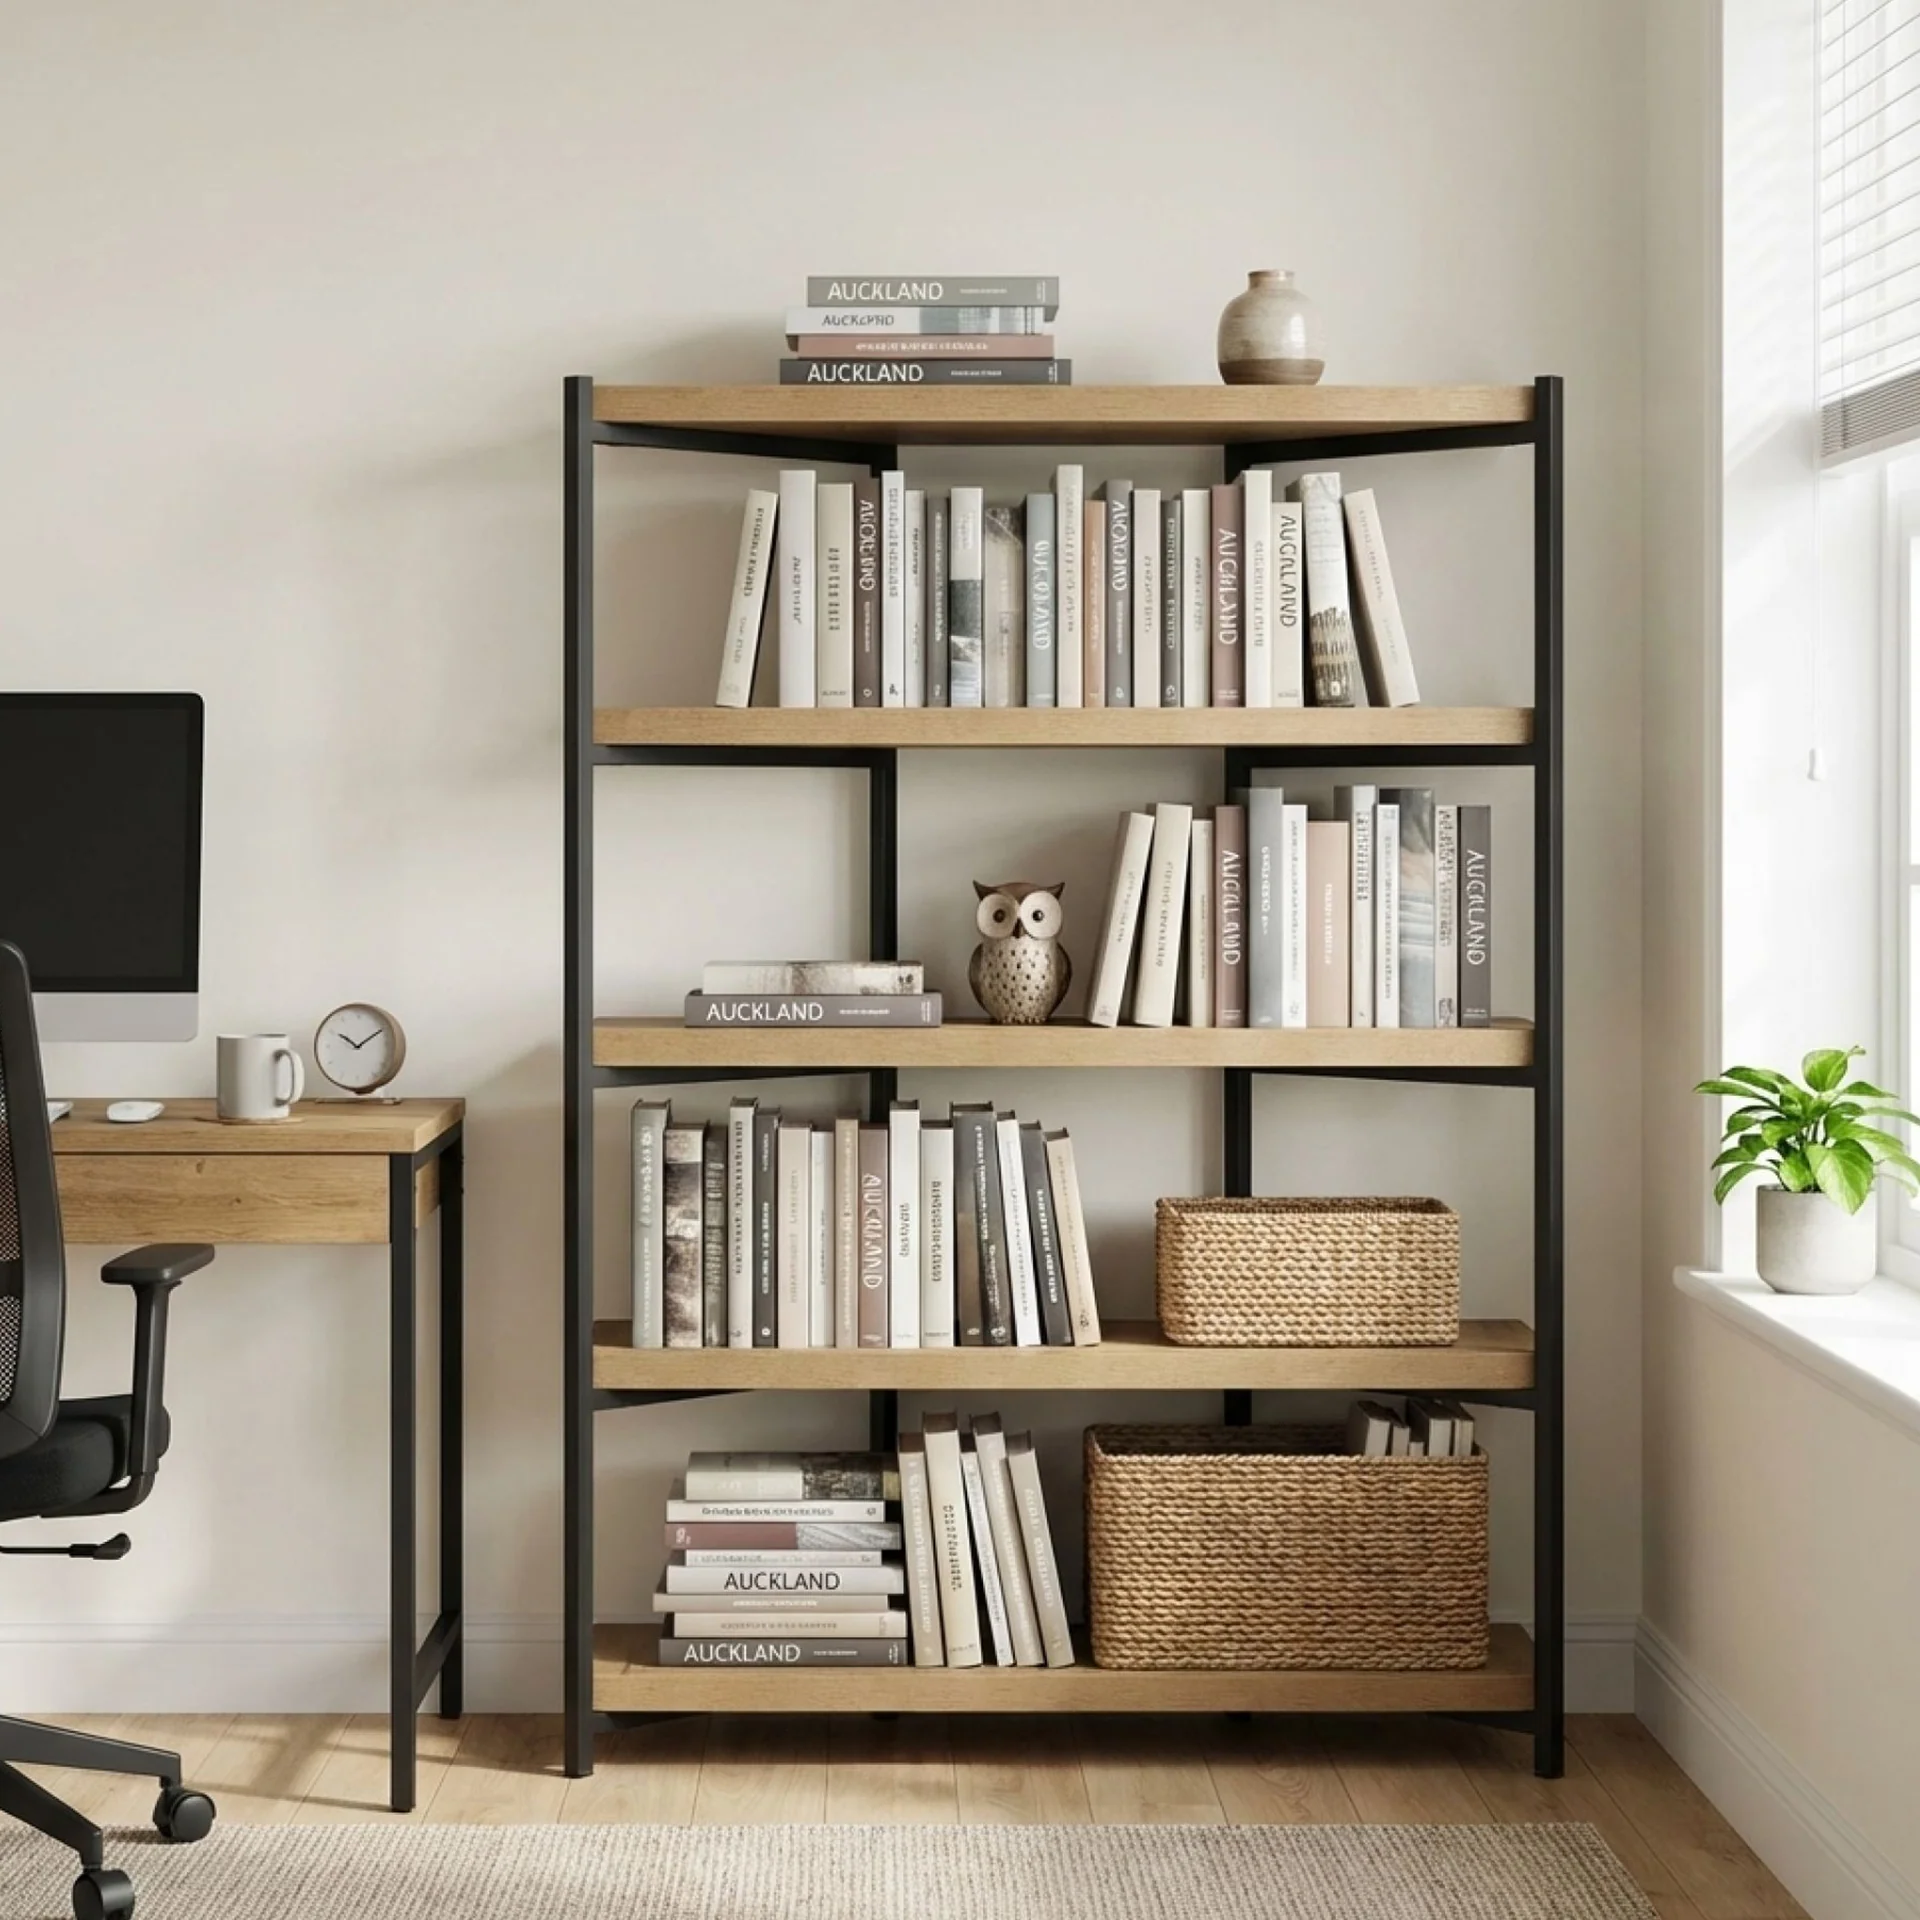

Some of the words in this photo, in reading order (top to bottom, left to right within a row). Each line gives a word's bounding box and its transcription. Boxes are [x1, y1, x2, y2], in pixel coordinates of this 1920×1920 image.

[827, 281, 944, 301] AUCKLAND
[807, 362, 924, 382] AUCKLAND
[706, 1002, 824, 1022] AUCKLAND
[724, 1571, 841, 1591] AUCKLAND
[684, 1643, 801, 1663] AUCKLAND
